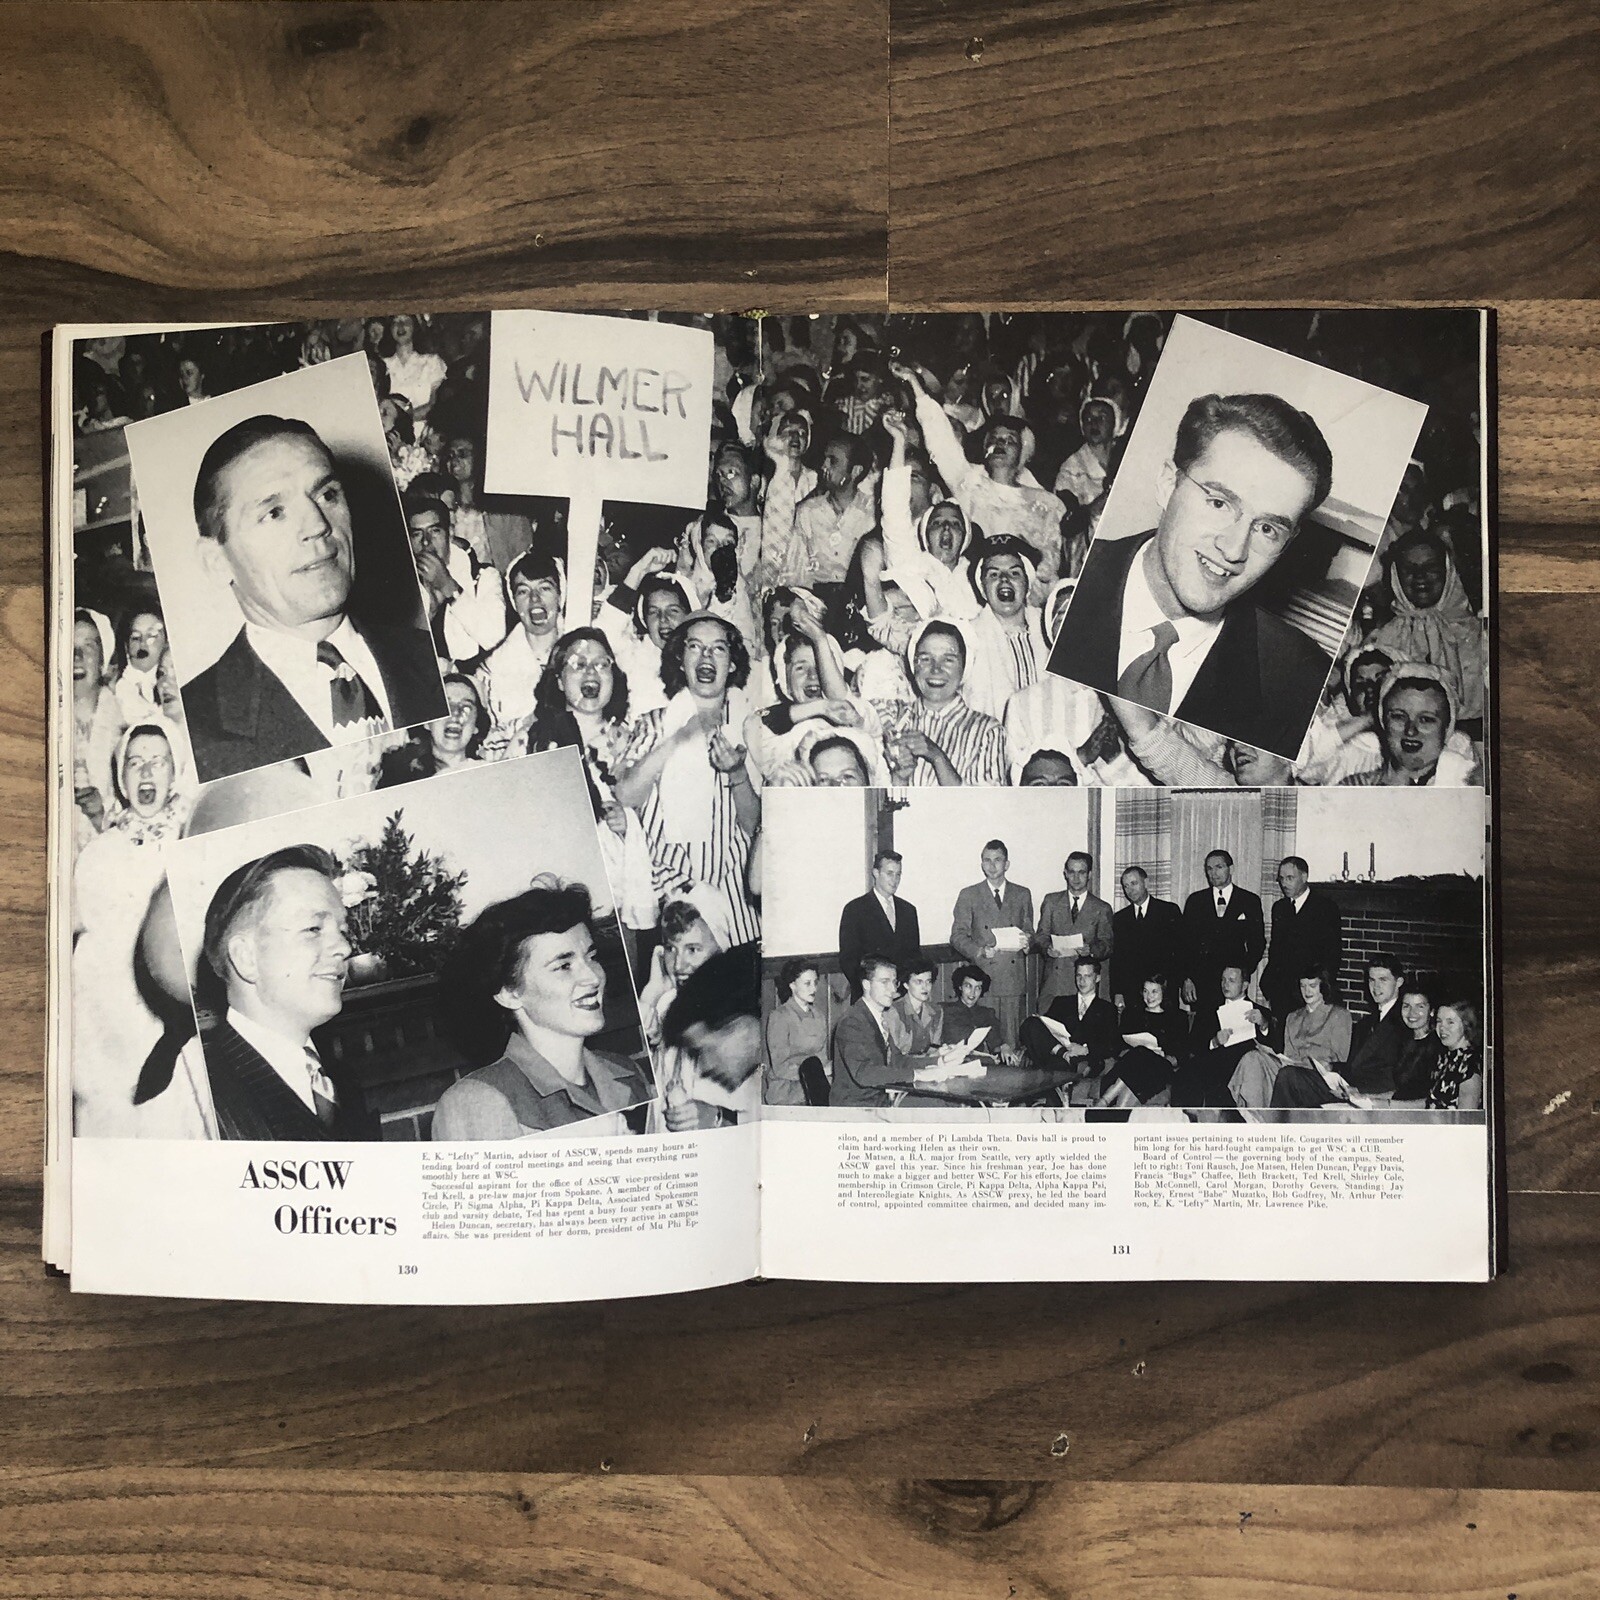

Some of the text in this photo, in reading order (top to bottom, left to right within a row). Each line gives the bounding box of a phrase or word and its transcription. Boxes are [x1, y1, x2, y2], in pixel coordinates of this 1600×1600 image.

[515, 358, 692, 419] WILMER
[552, 412, 668, 461] HALL
[1134, 1134, 1403, 1145] portant issues pertaining to student life. Cougarites will remember
[1134, 1142, 1148, 1151] him
[1152, 1143, 1169, 1153] long
[1174, 1143, 1184, 1151] for
[1189, 1143, 1200, 1151] his
[1205, 1143, 1250, 1154] hard-fought
[1255, 1144, 1293, 1154] campaign
[1298, 1144, 1305, 1152] to
[1310, 1144, 1321, 1154] get
[1326, 1144, 1346, 1152] WSC
[1360, 1144, 1381, 1152] CUB.
[422, 1161, 452, 1172] tending
[456, 1161, 479, 1170] board
[482, 1161, 490, 1169] of
[495, 1160, 523, 1169] control
[528, 1159, 564, 1170] meetings
[568, 1157, 583, 1167] and
[587, 1156, 612, 1168] seeing
[616, 1154, 631, 1164] that
[636, 1151, 677, 1165] everything
[838, 1161, 1106, 1172] ASSCW gavel this year. Since his freshman year, Joe has done
[1134, 1161, 1146, 1170] left
[1150, 1162, 1157, 1170] to
[1185, 1162, 1203, 1170] Toni
[1207, 1162, 1238, 1171] Rausch,
[1240, 1162, 1254, 1170] Joe
[1257, 1162, 1287, 1172] Matsen,
[1290, 1162, 1313, 1171] Helen
[1316, 1163, 1349, 1172] Duncan,
[1353, 1163, 1376, 1173] Peggy
[1380, 1163, 1404, 1173] Davis,
[239, 1160, 354, 1190] ASSCW
[431, 1181, 473, 1190] Successful
[478, 1181, 510, 1191] aspirant
[516, 1179, 526, 1188] for
[532, 1179, 544, 1187] the
[549, 1178, 570, 1187] office
[574, 1177, 582, 1186] of
[587, 1174, 620, 1185] ASSCW
[625, 1170, 679, 1184] vice-president
[838, 1171, 859, 1179] much
[873, 1171, 894, 1179] make
[905, 1171, 929, 1181] bigger
[933, 1171, 947, 1179] and
[951, 1171, 974, 1179] better
[978, 1171, 999, 1179] WSC.
[1004, 1171, 1016, 1179] For
[1020, 1171, 1032, 1179] his
[1034, 1171, 1061, 1180] efforts,
[1065, 1171, 1078, 1179] Joe
[1081, 1171, 1106, 1179] claims
[422, 1191, 437, 1200] Ted
[478, 1190, 507, 1201] pre-law
[512, 1191, 536, 1200] major
[541, 1188, 560, 1197] from
[565, 1185, 602, 1198] Spokane.
[617, 1182, 649, 1192] member
[653, 1181, 662, 1190] of
[666, 1179, 698, 1189] Crimson
[838, 1180, 885, 1191] membership
[900, 1180, 933, 1188] Crimson
[937, 1180, 962, 1190] Circle,
[966, 1180, 974, 1188] Pi
[979, 1180, 1004, 1191] Kappa
[1008, 1180, 1031, 1190] Delta,
[1035, 1180, 1058, 1191] Alpha
[1062, 1180, 1088, 1191] Kappa
[1092, 1180, 1106, 1190] Psi,
[1134, 1180, 1402, 1192] Bob McConnell, Carol Morgan, Dorothy Gevers. Standing: Jay
[422, 1189, 698, 1211] Circle, Pi Sigma Alpha, Pi Kappa Delta, Associated Spokesmen
[838, 1190, 1106, 1200] and Intercollegiate Knights. As ASSCW prexy, he led the board
[837, 1199, 1106, 1210] of control, appointed committee chairmen, and decided many im-
[274, 1204, 397, 1235] Officers
[422, 1230, 448, 1239] affairs.
[454, 1230, 468, 1239] She
[493, 1229, 530, 1240] president
[535, 1228, 543, 1237] of
[548, 1227, 562, 1236] her
[566, 1226, 590, 1237] dorm,
[595, 1223, 632, 1236] president
[636, 1222, 644, 1231] of
[650, 1221, 662, 1230] Mu
[668, 1219, 680, 1229] Phi
[685, 1218, 698, 1229] Ep-
[1112, 1244, 1131, 1255] 131
[398, 1265, 418, 1275] 130
